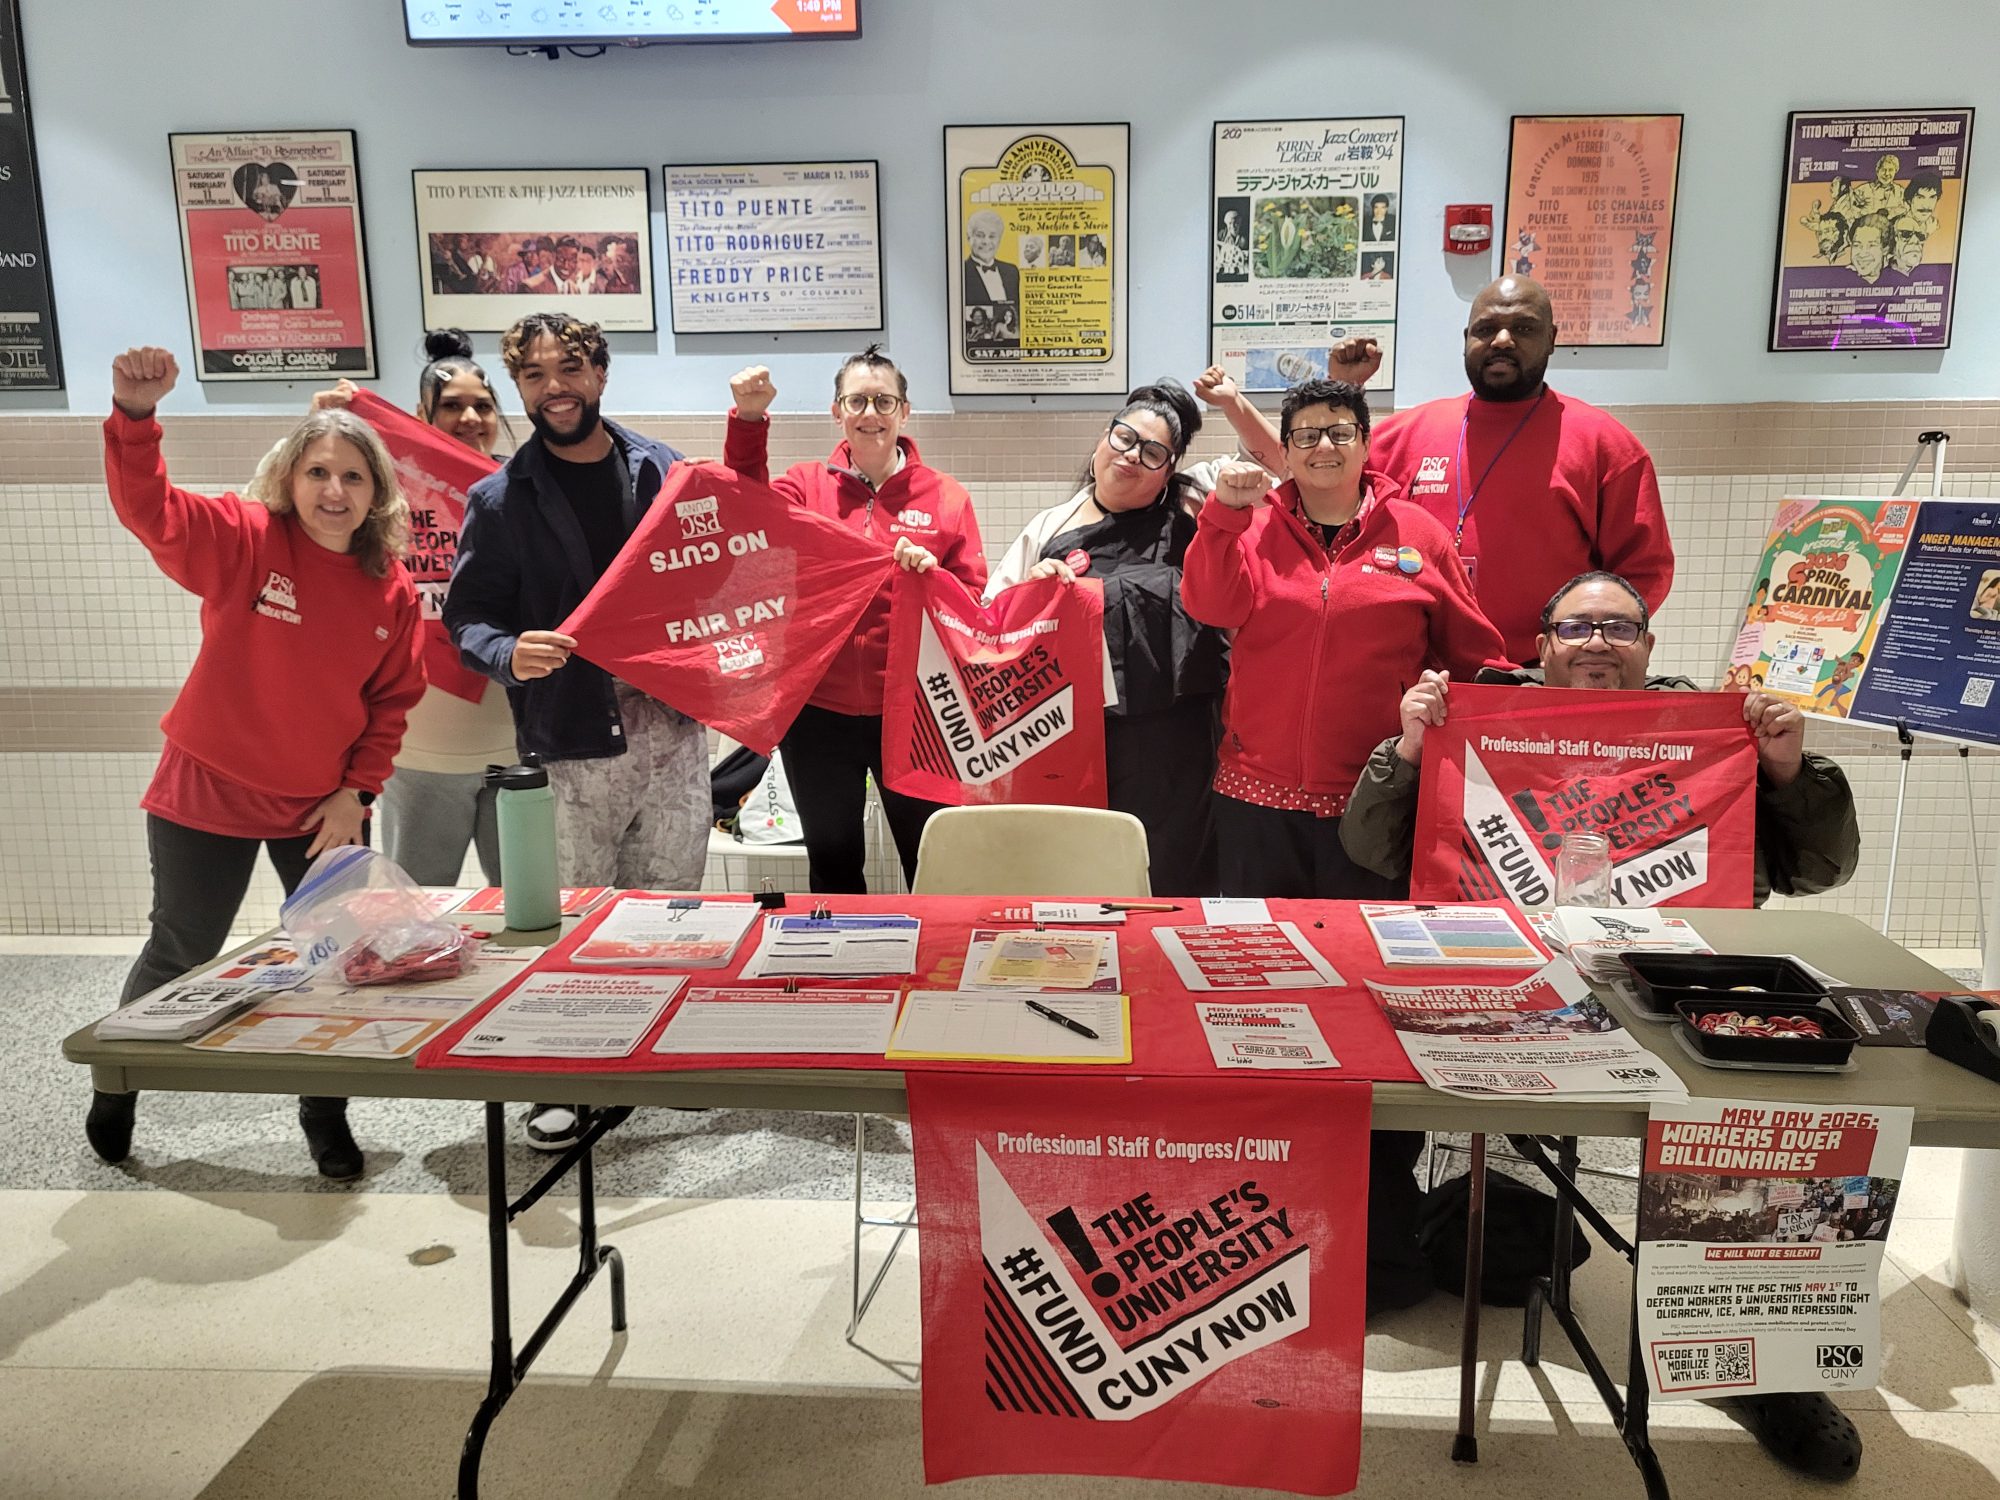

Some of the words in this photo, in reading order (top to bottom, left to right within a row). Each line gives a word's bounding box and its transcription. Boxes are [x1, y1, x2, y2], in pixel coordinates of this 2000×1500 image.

[823, 0, 842, 12] PM
[1801, 125, 1821, 139] TITO
[1822, 124, 1855, 138] PUENTE
[1856, 122, 1919, 137] SCHOLARSHIP
[1920, 120, 1961, 135] CONCERT
[1277, 140, 1314, 152] KIRIN
[1318, 129, 1347, 150] Jazz
[1348, 127, 1398, 145] Concert
[1851, 138, 1859, 148] AT
[1859, 137, 1885, 147] LINCOLN
[1886, 136, 1910, 147] CENTER
[1576, 140, 1610, 154] FEBRERO
[1937, 147, 1958, 156] AVERY
[1280, 151, 1322, 163] LAGER
[1334, 152, 1346, 162] at
[187, 171, 225, 180] SATURDAY
[307, 169, 346, 178] SATURDAY
[1582, 171, 1599, 183] 1975
[189, 181, 227, 190] FEBRUARY
[308, 179, 347, 188] FEBRUARY
[999, 183, 1077, 198] APOLLO
[1236, 173, 1380, 193] ラテン・ジャズ・カーニバル
[426, 184, 455, 199] TITO
[459, 184, 506, 199] PUENTE
[510, 186, 518, 199] &
[521, 184, 544, 202] THE
[549, 184, 576, 202] JAZZ
[580, 184, 635, 199] LEGENDS
[679, 200, 724, 218] TITO
[738, 198, 813, 216] PUENTE
[1538, 199, 1560, 211] TITO
[1587, 200, 1607, 211] LOS
[1610, 199, 1665, 211] CHAVALES
[1528, 213, 1569, 225] PUENTE
[1594, 213, 1609, 225] DE
[1612, 211, 1654, 224] ESPAÑA
[223, 234, 260, 252] TITO
[263, 233, 321, 251] PUENTE
[675, 235, 715, 253] TITO
[727, 233, 825, 252] RODRIGUEZ
[1547, 233, 1574, 243] DANIEL
[1577, 232, 1607, 243] SANTOS
[678, 267, 753, 286] FREDDY
[767, 265, 825, 284] PRICE
[691, 292, 770, 304] KNIGHTS
[780, 289, 793, 297] OF
[802, 288, 863, 297] COLUMBUS
[232, 353, 285, 367] COLGATE
[287, 352, 338, 366] GARDENS
[1420, 457, 1450, 472] PSC
[681, 499, 714, 516] CUNY
[727, 529, 769, 557] NO
[1919, 533, 1951, 544] ANGER
[1921, 544, 1947, 553] Practical
[1947, 545, 1962, 554] Tools
[649, 541, 721, 574] CUTS
[1805, 551, 1850, 571] 2026
[1772, 583, 1873, 611] CARNIVAL
[665, 612, 731, 643] FAIR
[734, 596, 787, 627] PAY
[975, 645, 1049, 704] PEOPLE'S
[976, 657, 1064, 731] UNIVERSITY
[926, 671, 975, 753] #FUND
[966, 734, 1024, 779] CUNY
[1023, 705, 1066, 748] NOW
[1480, 735, 1556, 755] Professional
[1558, 739, 1590, 757] Staff
[1593, 741, 1694, 762] Congress/CUNY
[1542, 778, 1598, 817] THE
[1559, 773, 1676, 834] PEOPLE'S
[1476, 813, 1551, 907] #FUND
[1627, 850, 1698, 898] NOW
[158, 990, 240, 1003] ICE
[1386, 999, 1518, 1010] BILLIONAIRES
[1720, 1107, 1768, 1126] MAY
[1770, 1109, 1816, 1129] DAY
[1821, 1112, 1880, 1130] 2026:
[1661, 1123, 1775, 1149] WORKERS
[1779, 1129, 1843, 1151] OVER
[997, 1131, 1102, 1158] Professional
[1107, 1135, 1150, 1159] Staff
[1154, 1135, 1292, 1164] Congress/CUNY
[1659, 1145, 1819, 1172] BILLIONAIRES
[1091, 1191, 1166, 1249] THE
[1113, 1180, 1271, 1284] PEOPLE'S
[1706, 1249, 1722, 1259] WE
[1723, 1249, 1746, 1259] WILL
[1748, 1249, 1767, 1258] NOT
[1769, 1249, 1782, 1258] BE
[1783, 1249, 1820, 1258] SILENT!
[1103, 1206, 1296, 1333] UNIVERSITY
[1656, 1284, 1705, 1296] ORGANIZE
[1708, 1284, 1732, 1295] WITH
[1735, 1284, 1755, 1294] THE
[1757, 1283, 1776, 1293] PSC
[1779, 1283, 1802, 1293] THIS
[1804, 1282, 1827, 1292] MAY
[1844, 1282, 1858, 1292] TO
[1646, 1297, 1684, 1308] DEFEND
[1687, 1296, 1733, 1307] WORKERS
[1735, 1296, 1743, 1305] &
[1746, 1294, 1813, 1305] UNIVERSITIES
[1816, 1294, 1838, 1303] AND
[1840, 1293, 1871, 1304] FIGHT
[1000, 1246, 1107, 1376] #FUND
[1656, 1307, 1714, 1319] OLIGARCHY,
[1716, 1307, 1736, 1317] ICE,
[1739, 1307, 1764, 1317] WAR,
[1767, 1306, 1789, 1316] AND
[1791, 1304, 1858, 1316] REPRESSION.
[1096, 1325, 1211, 1411] CUNY
[1209, 1280, 1298, 1350] NOW
[1658, 1349, 1693, 1361] PLEDGE
[1696, 1349, 1709, 1358] TO
[1817, 1345, 1863, 1368] PSC
[1667, 1359, 1709, 1371] MOBILIZE
[1670, 1371, 1692, 1382] WITH
[1694, 1371, 1710, 1381] US:
[1821, 1368, 1858, 1379] CUNY
